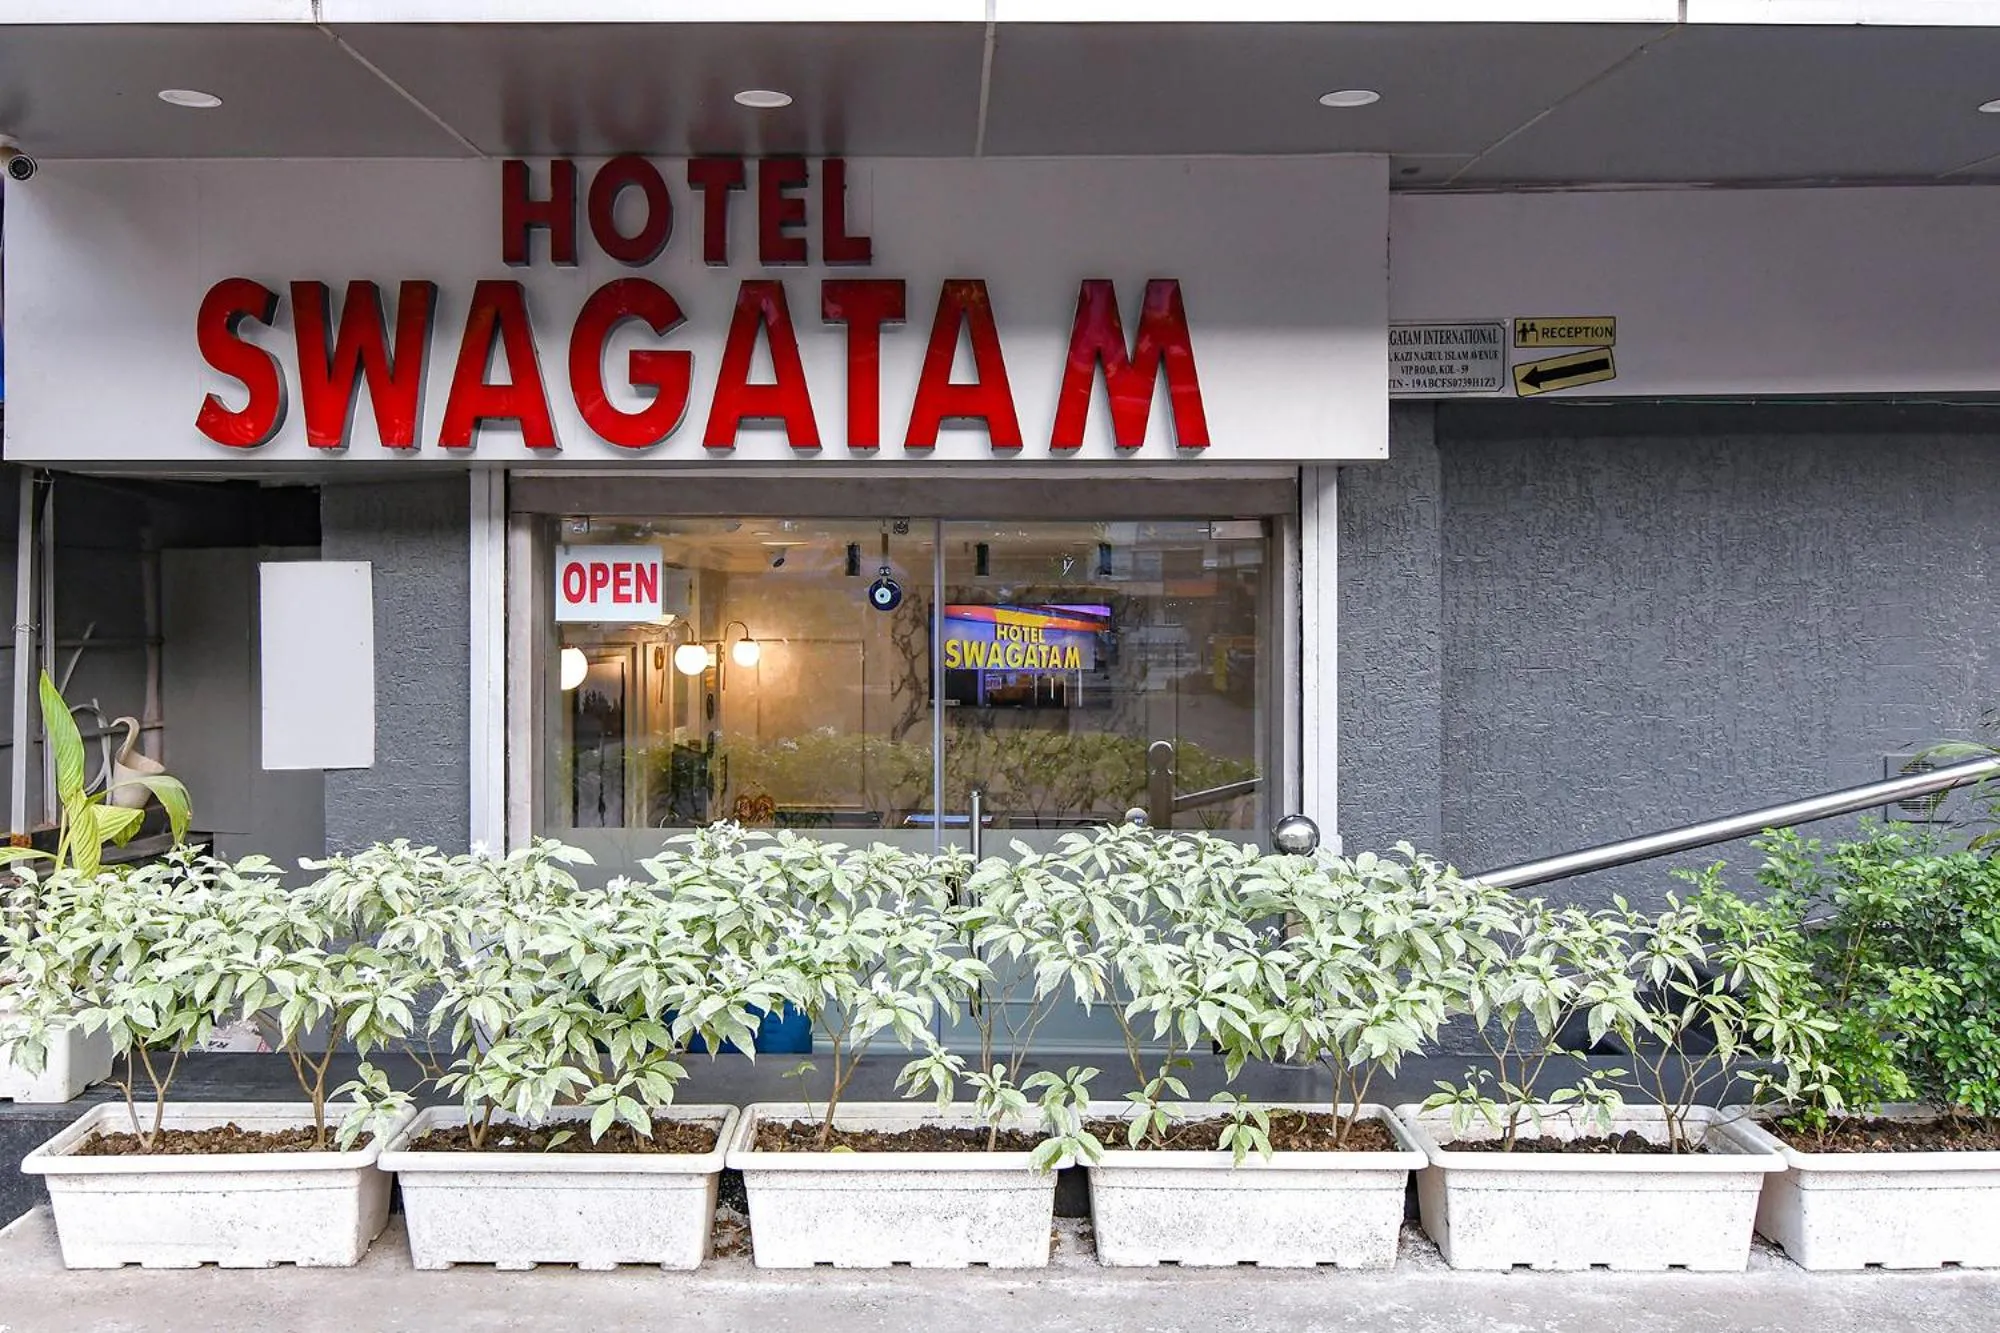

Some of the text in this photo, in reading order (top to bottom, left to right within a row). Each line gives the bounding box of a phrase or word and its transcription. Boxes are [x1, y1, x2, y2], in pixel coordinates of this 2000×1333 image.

[502, 154, 872, 267] HOTEL
[1388, 328, 1499, 345] GATAM INTERNATIONAL
[1542, 326, 1613, 338] RECEPTION
[195, 277, 1211, 452] SWAGATAM
[1394, 351, 1412, 361] KAZI
[1444, 350, 1469, 360] ISLAM
[1471, 349, 1499, 360] AVENUE
[1400, 365, 1414, 375] VIP
[1414, 365, 1438, 375] ROAD,
[563, 561, 658, 604] OPEN
[996, 624, 1046, 643] HOTEL
[945, 639, 1081, 669] SWAGATAM
